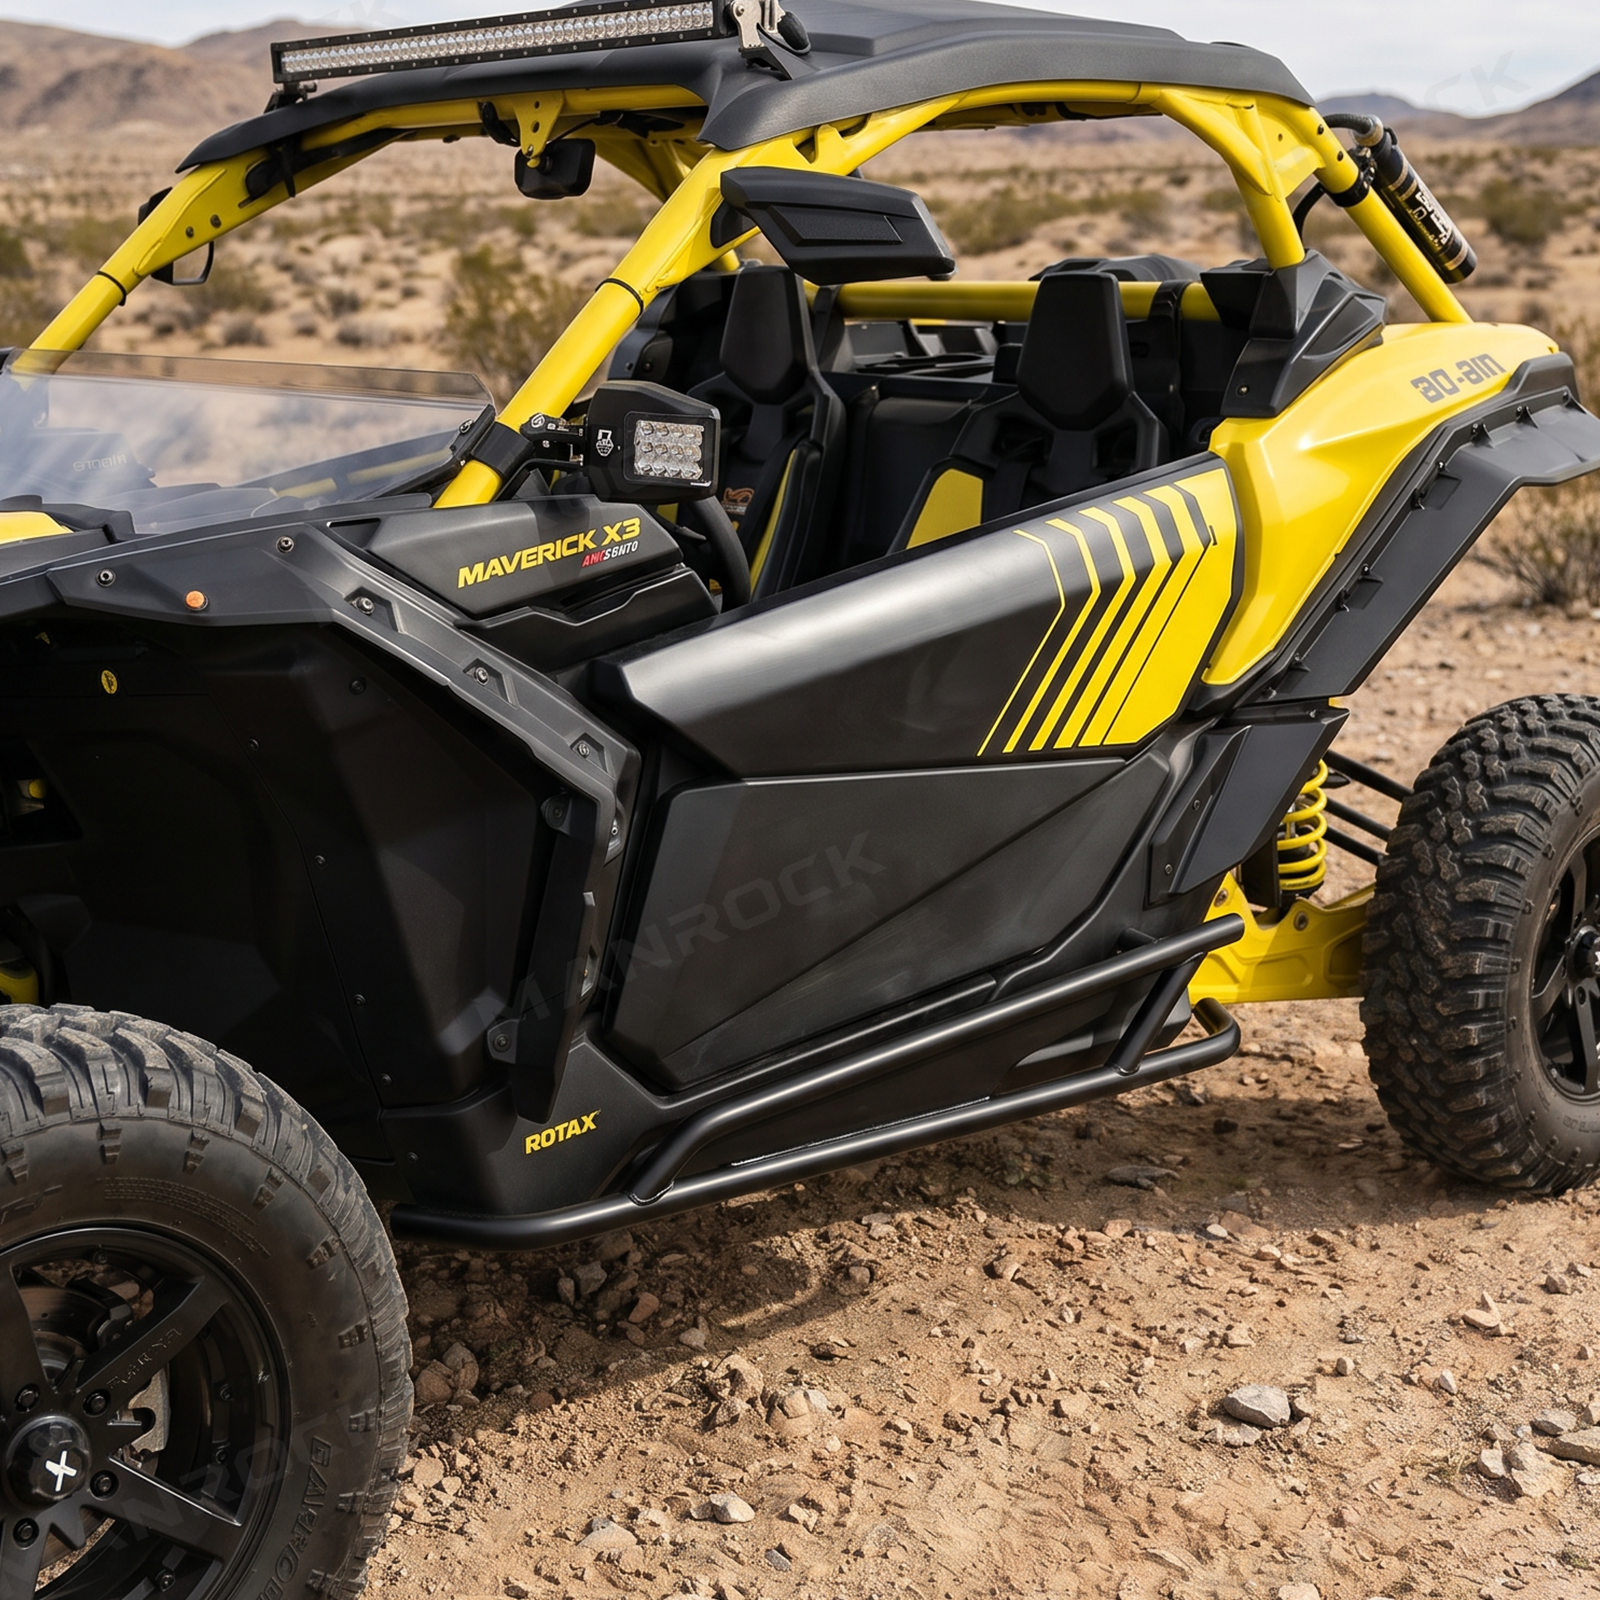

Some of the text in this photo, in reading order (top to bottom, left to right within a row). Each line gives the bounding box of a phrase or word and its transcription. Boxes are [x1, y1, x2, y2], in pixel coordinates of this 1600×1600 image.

[457, 516, 642, 589] MAVERICK X3
[525, 1111, 600, 1155] ROTAX
